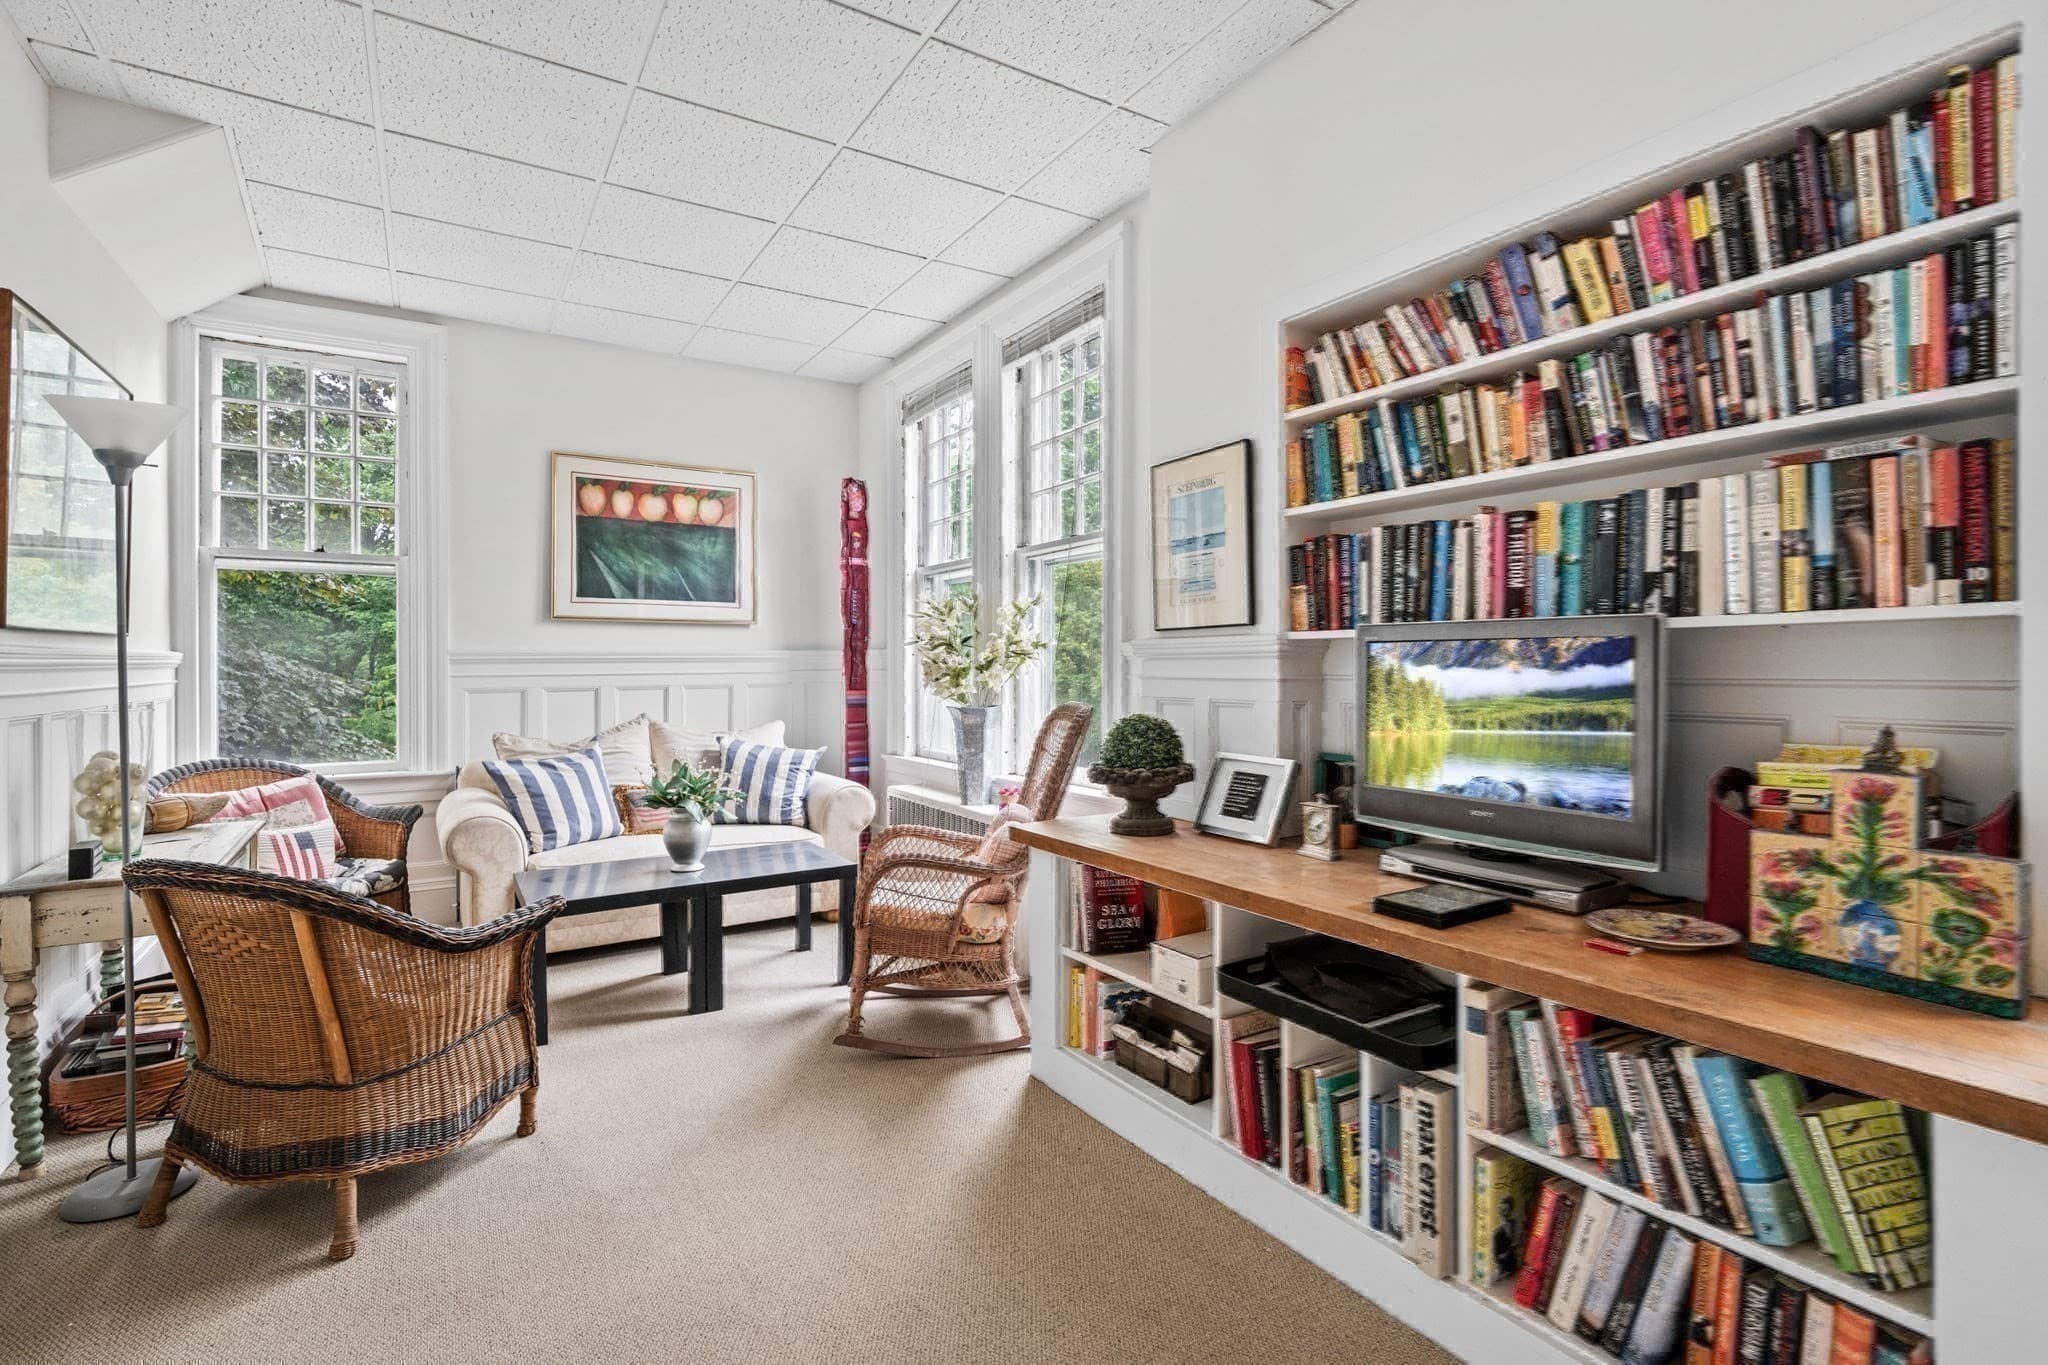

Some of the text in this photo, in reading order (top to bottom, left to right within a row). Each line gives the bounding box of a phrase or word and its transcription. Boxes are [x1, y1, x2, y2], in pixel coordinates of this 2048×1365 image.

[1095, 879, 1140, 888] PHILBRICK
[1101, 904, 1127, 916] SEA
[1097, 917, 1142, 929] GLORY
[1418, 1100, 1439, 1239] max ernst
